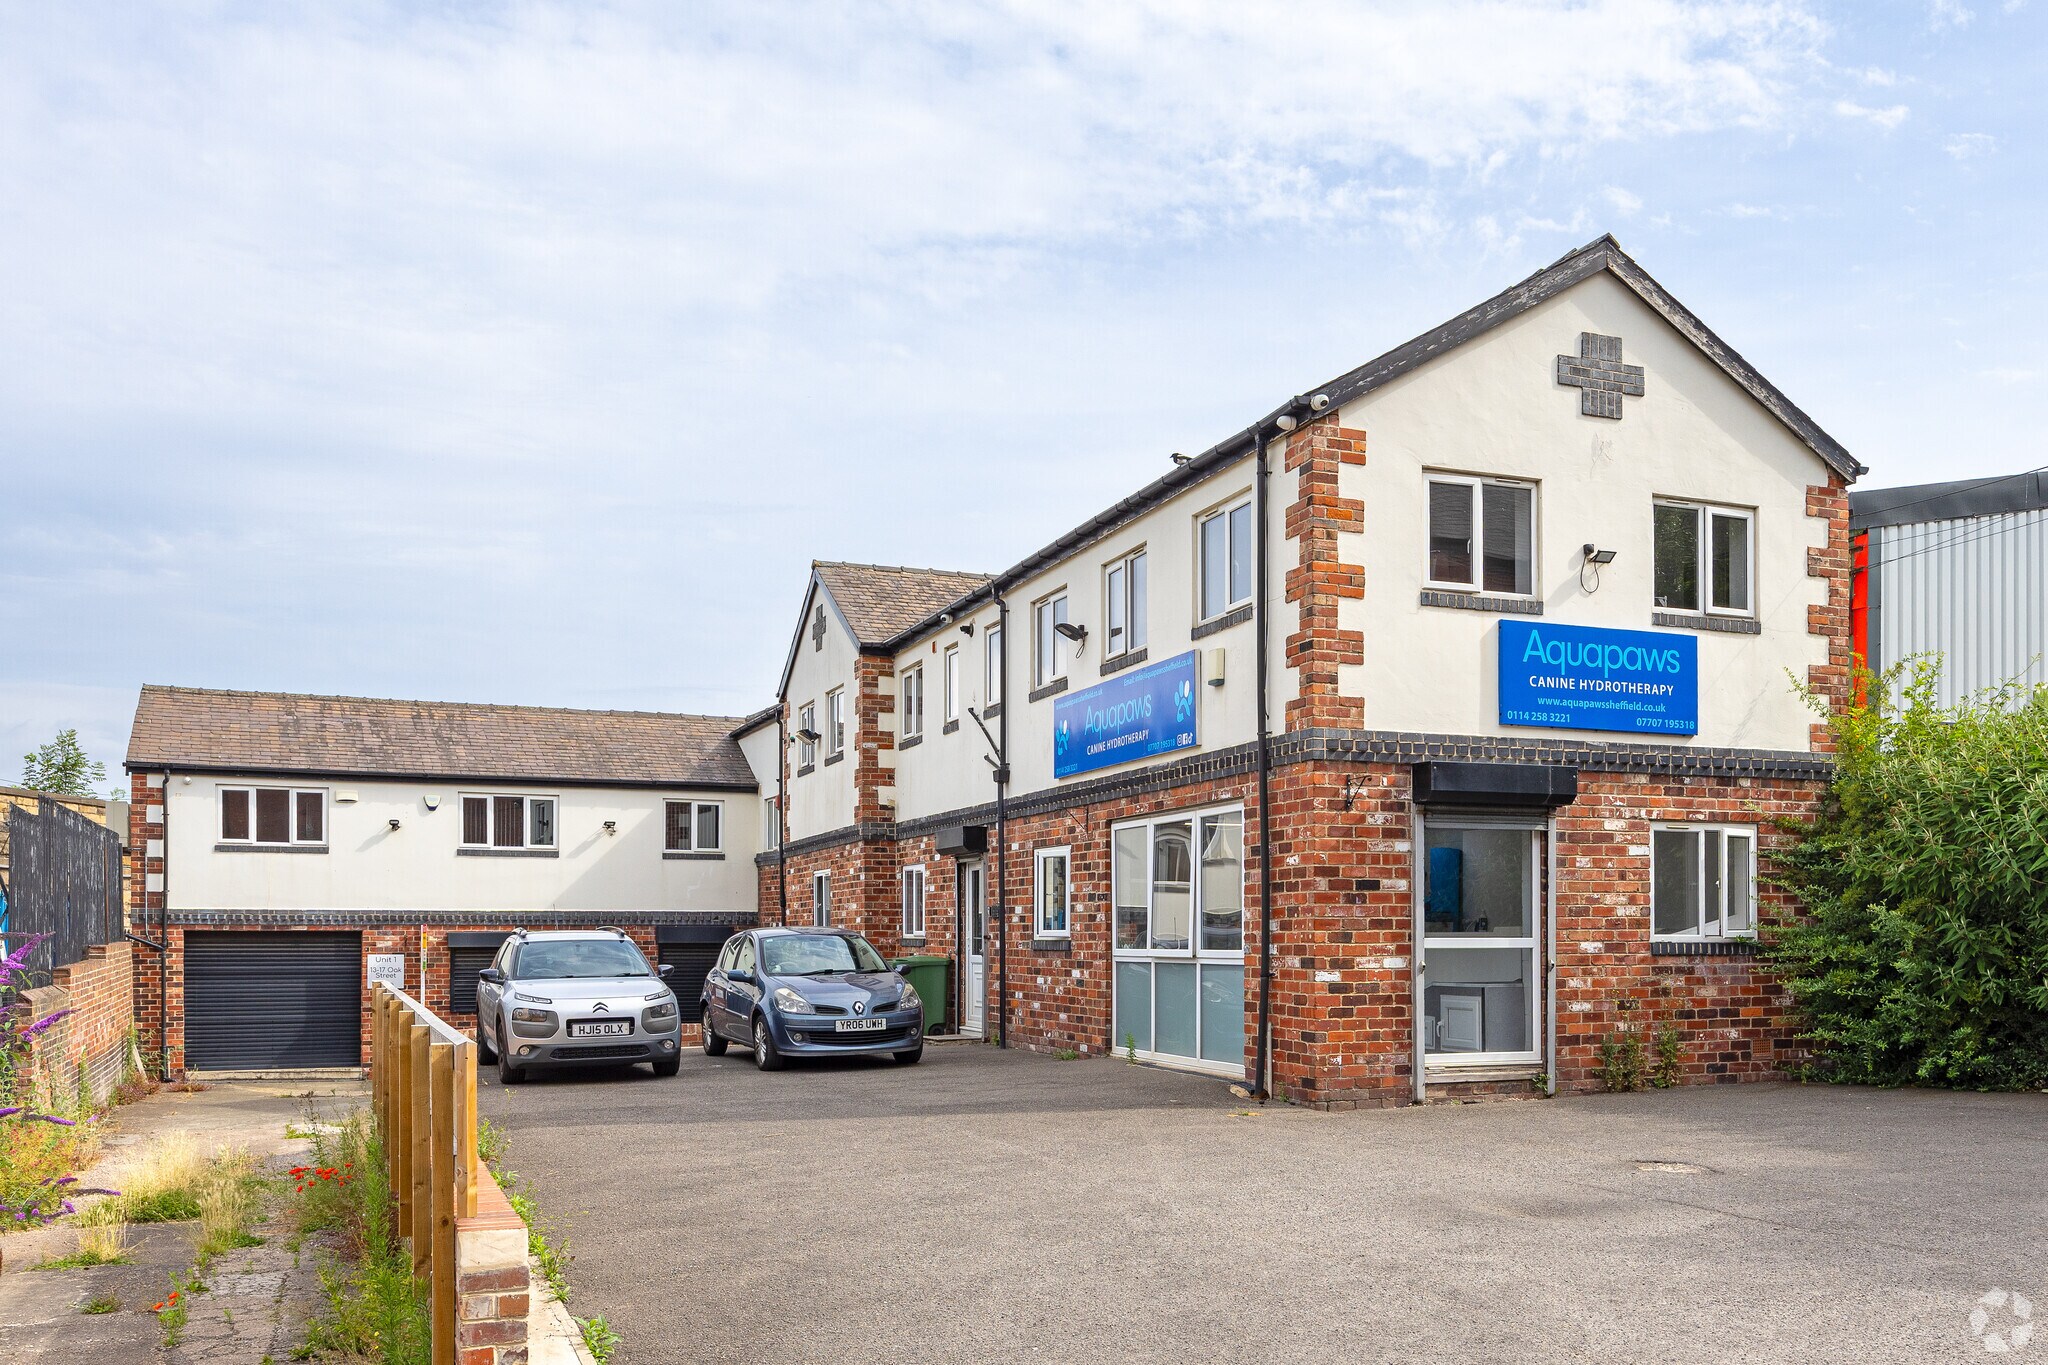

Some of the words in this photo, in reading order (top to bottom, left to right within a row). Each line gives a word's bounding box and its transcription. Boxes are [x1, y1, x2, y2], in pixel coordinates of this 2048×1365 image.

[1522, 629, 1681, 678] Aquapaws
[1529, 675, 1576, 689] CANINE
[1579, 679, 1674, 696] HYDROTHERAPY
[1537, 697, 1666, 713] www.aquapawssheffield.co.uk
[1084, 693, 1152, 740] Aquapaws
[1507, 710, 1530, 720] 0114
[1531, 711, 1548, 721] 258
[1549, 712, 1571, 723] 3221
[1636, 717, 1663, 727] 07707
[1664, 719, 1695, 730] 195318
[1086, 741, 1106, 756] CANINE
[1106, 729, 1150, 750] HYDROTHERAPY
[578, 1025, 602, 1035] HJ15
[603, 1024, 624, 1034] OLX
[840, 1020, 864, 1030] YR06
[865, 1019, 883, 1029] UWH
